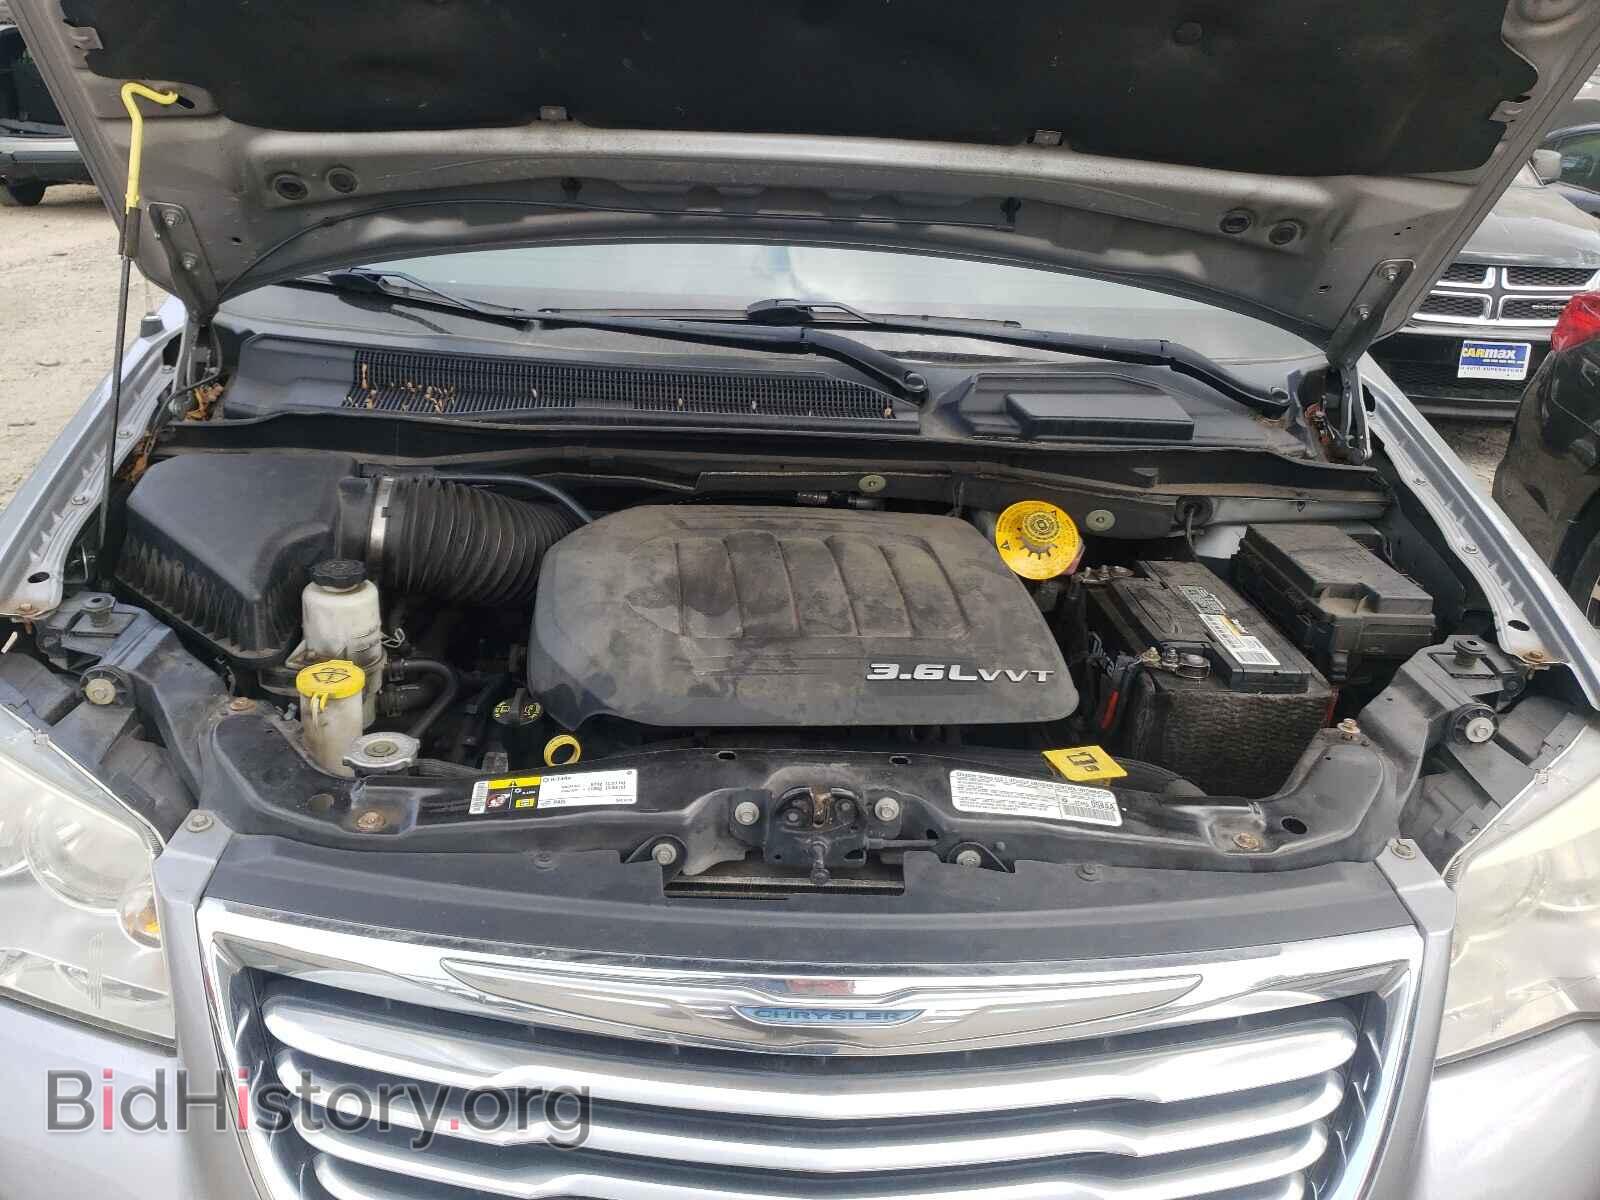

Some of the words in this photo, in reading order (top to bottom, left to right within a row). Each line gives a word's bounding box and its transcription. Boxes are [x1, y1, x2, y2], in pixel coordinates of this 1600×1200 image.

[866, 663, 978, 682] 3.6L
[977, 668, 1055, 683] VVT
[754, 1008, 899, 1021] CHRYSLER
